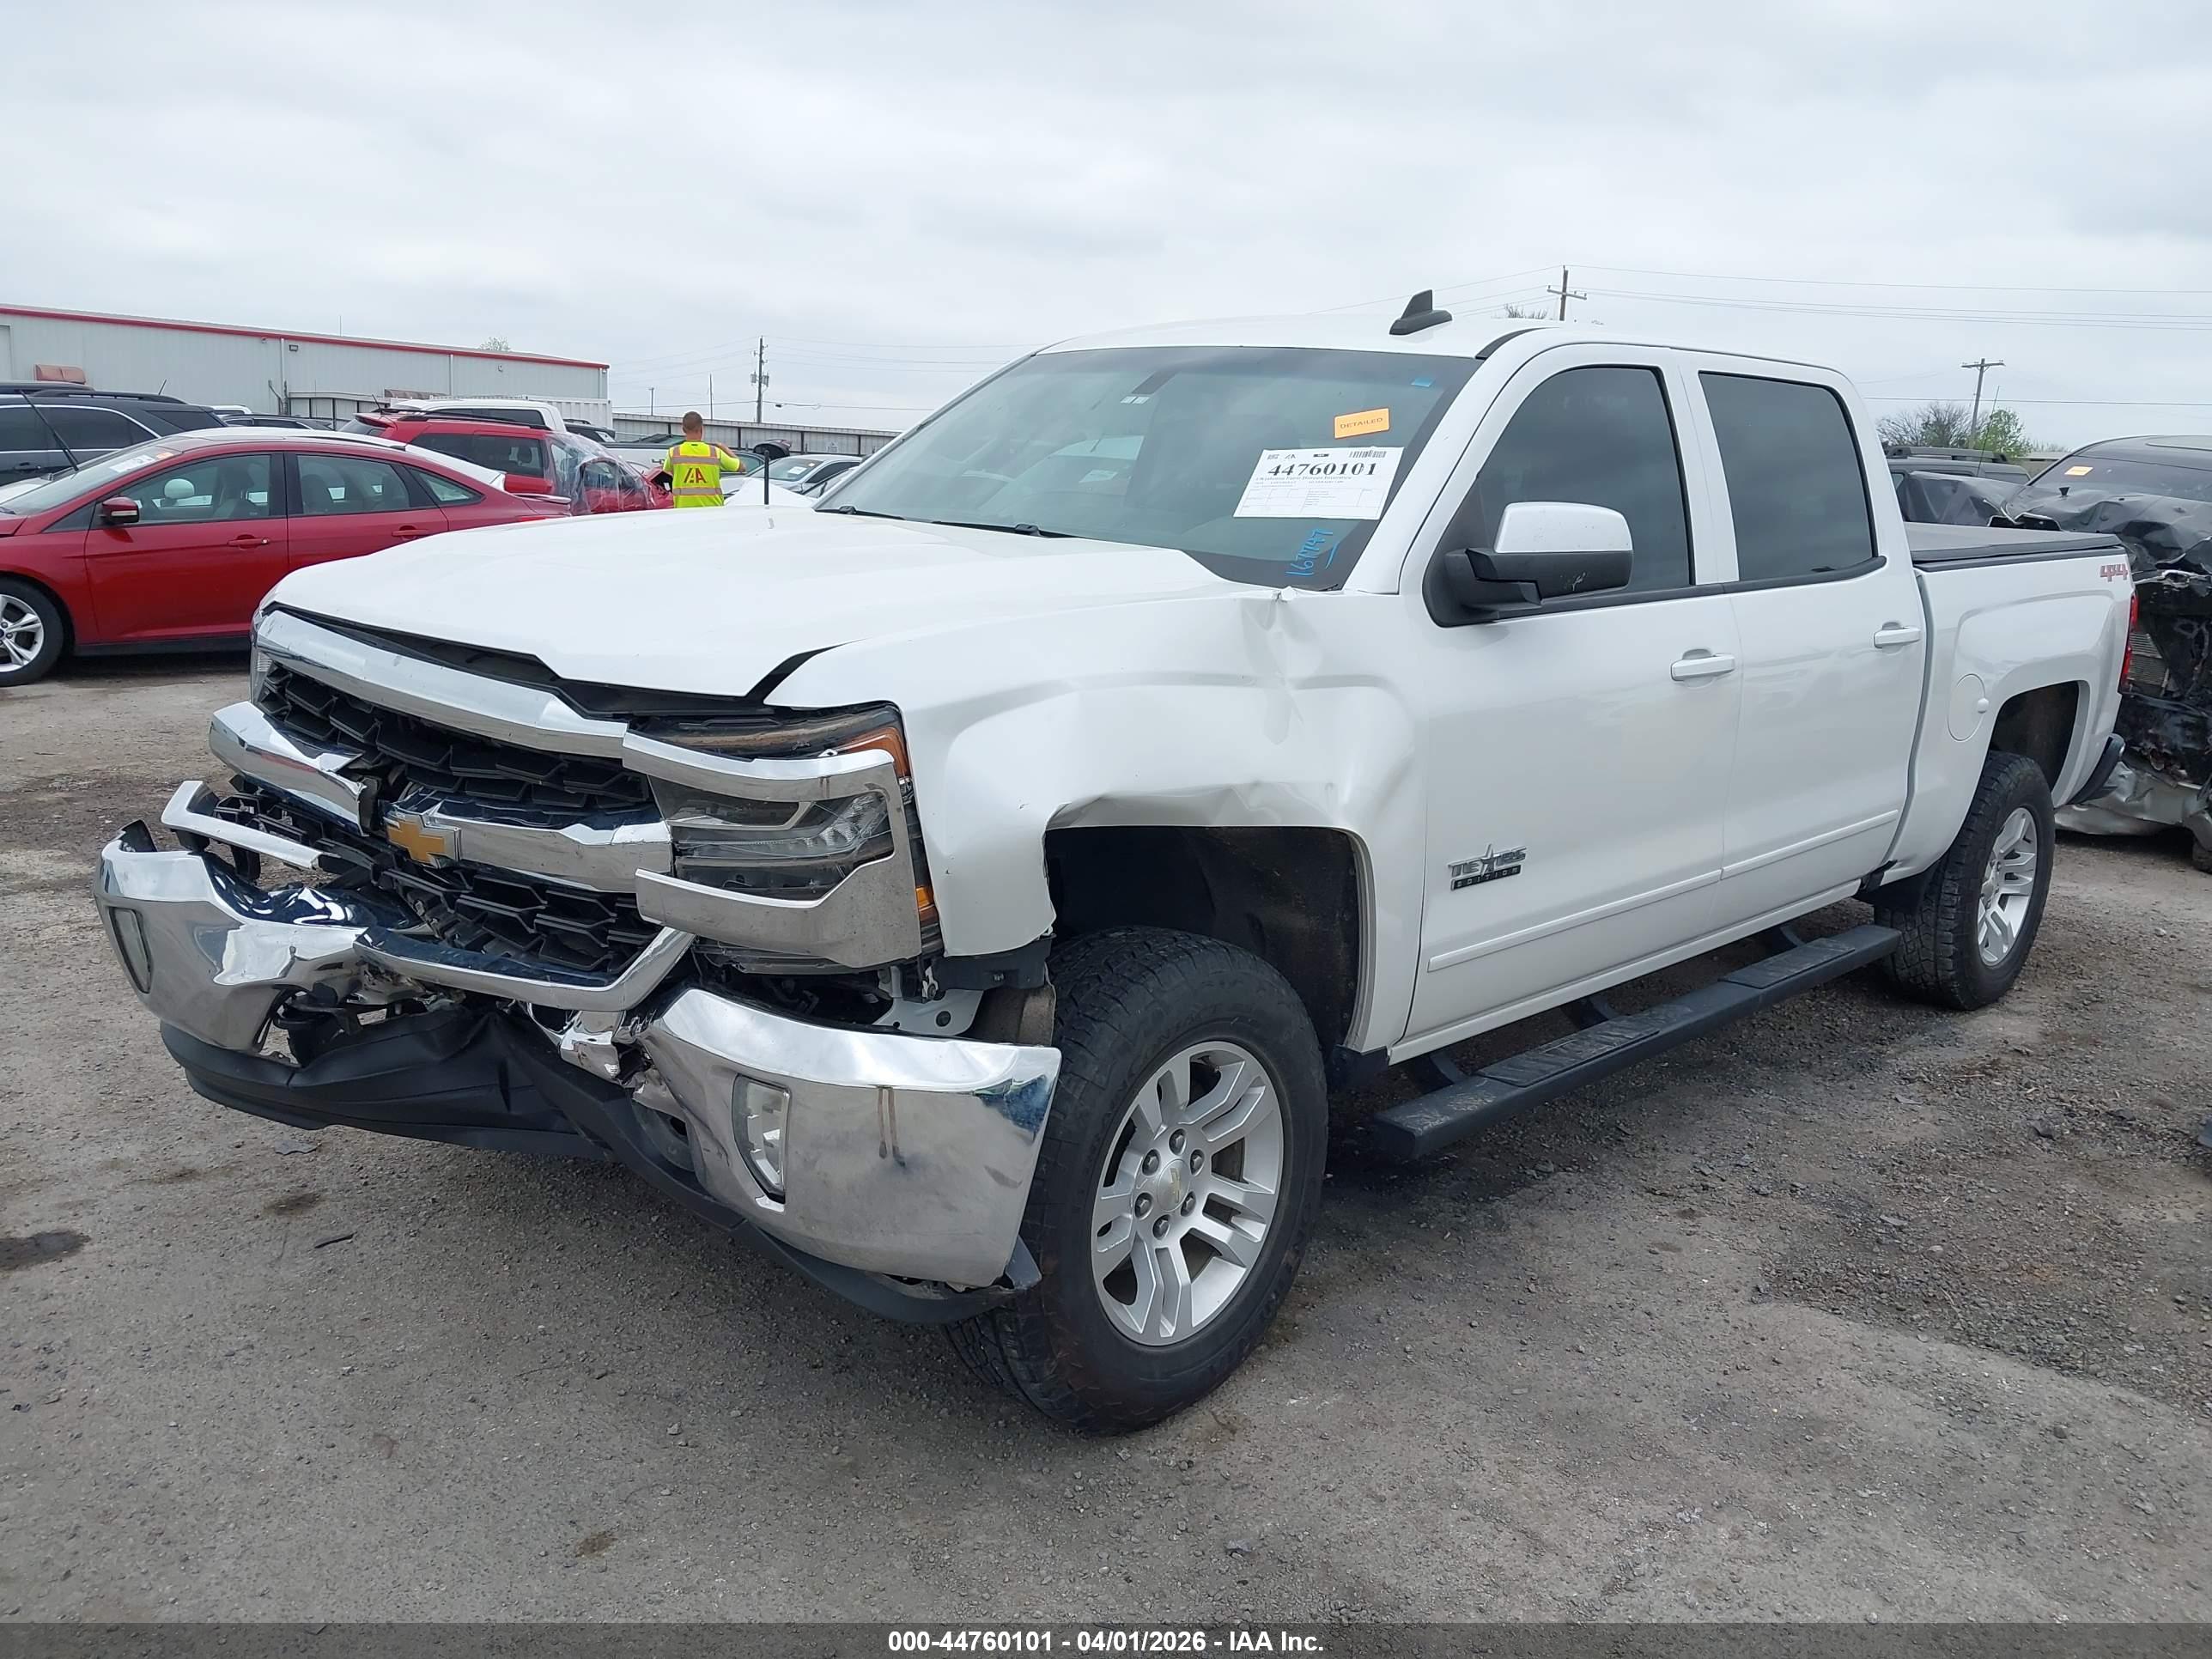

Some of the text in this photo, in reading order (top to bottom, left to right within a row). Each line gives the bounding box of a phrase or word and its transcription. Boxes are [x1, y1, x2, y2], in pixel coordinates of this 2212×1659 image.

[1340, 417, 1383, 429] DETAILED
[1267, 462, 1377, 477] 44760101
[1447, 844, 1527, 878] TEXAS
[1455, 866, 1520, 888] EDITION
